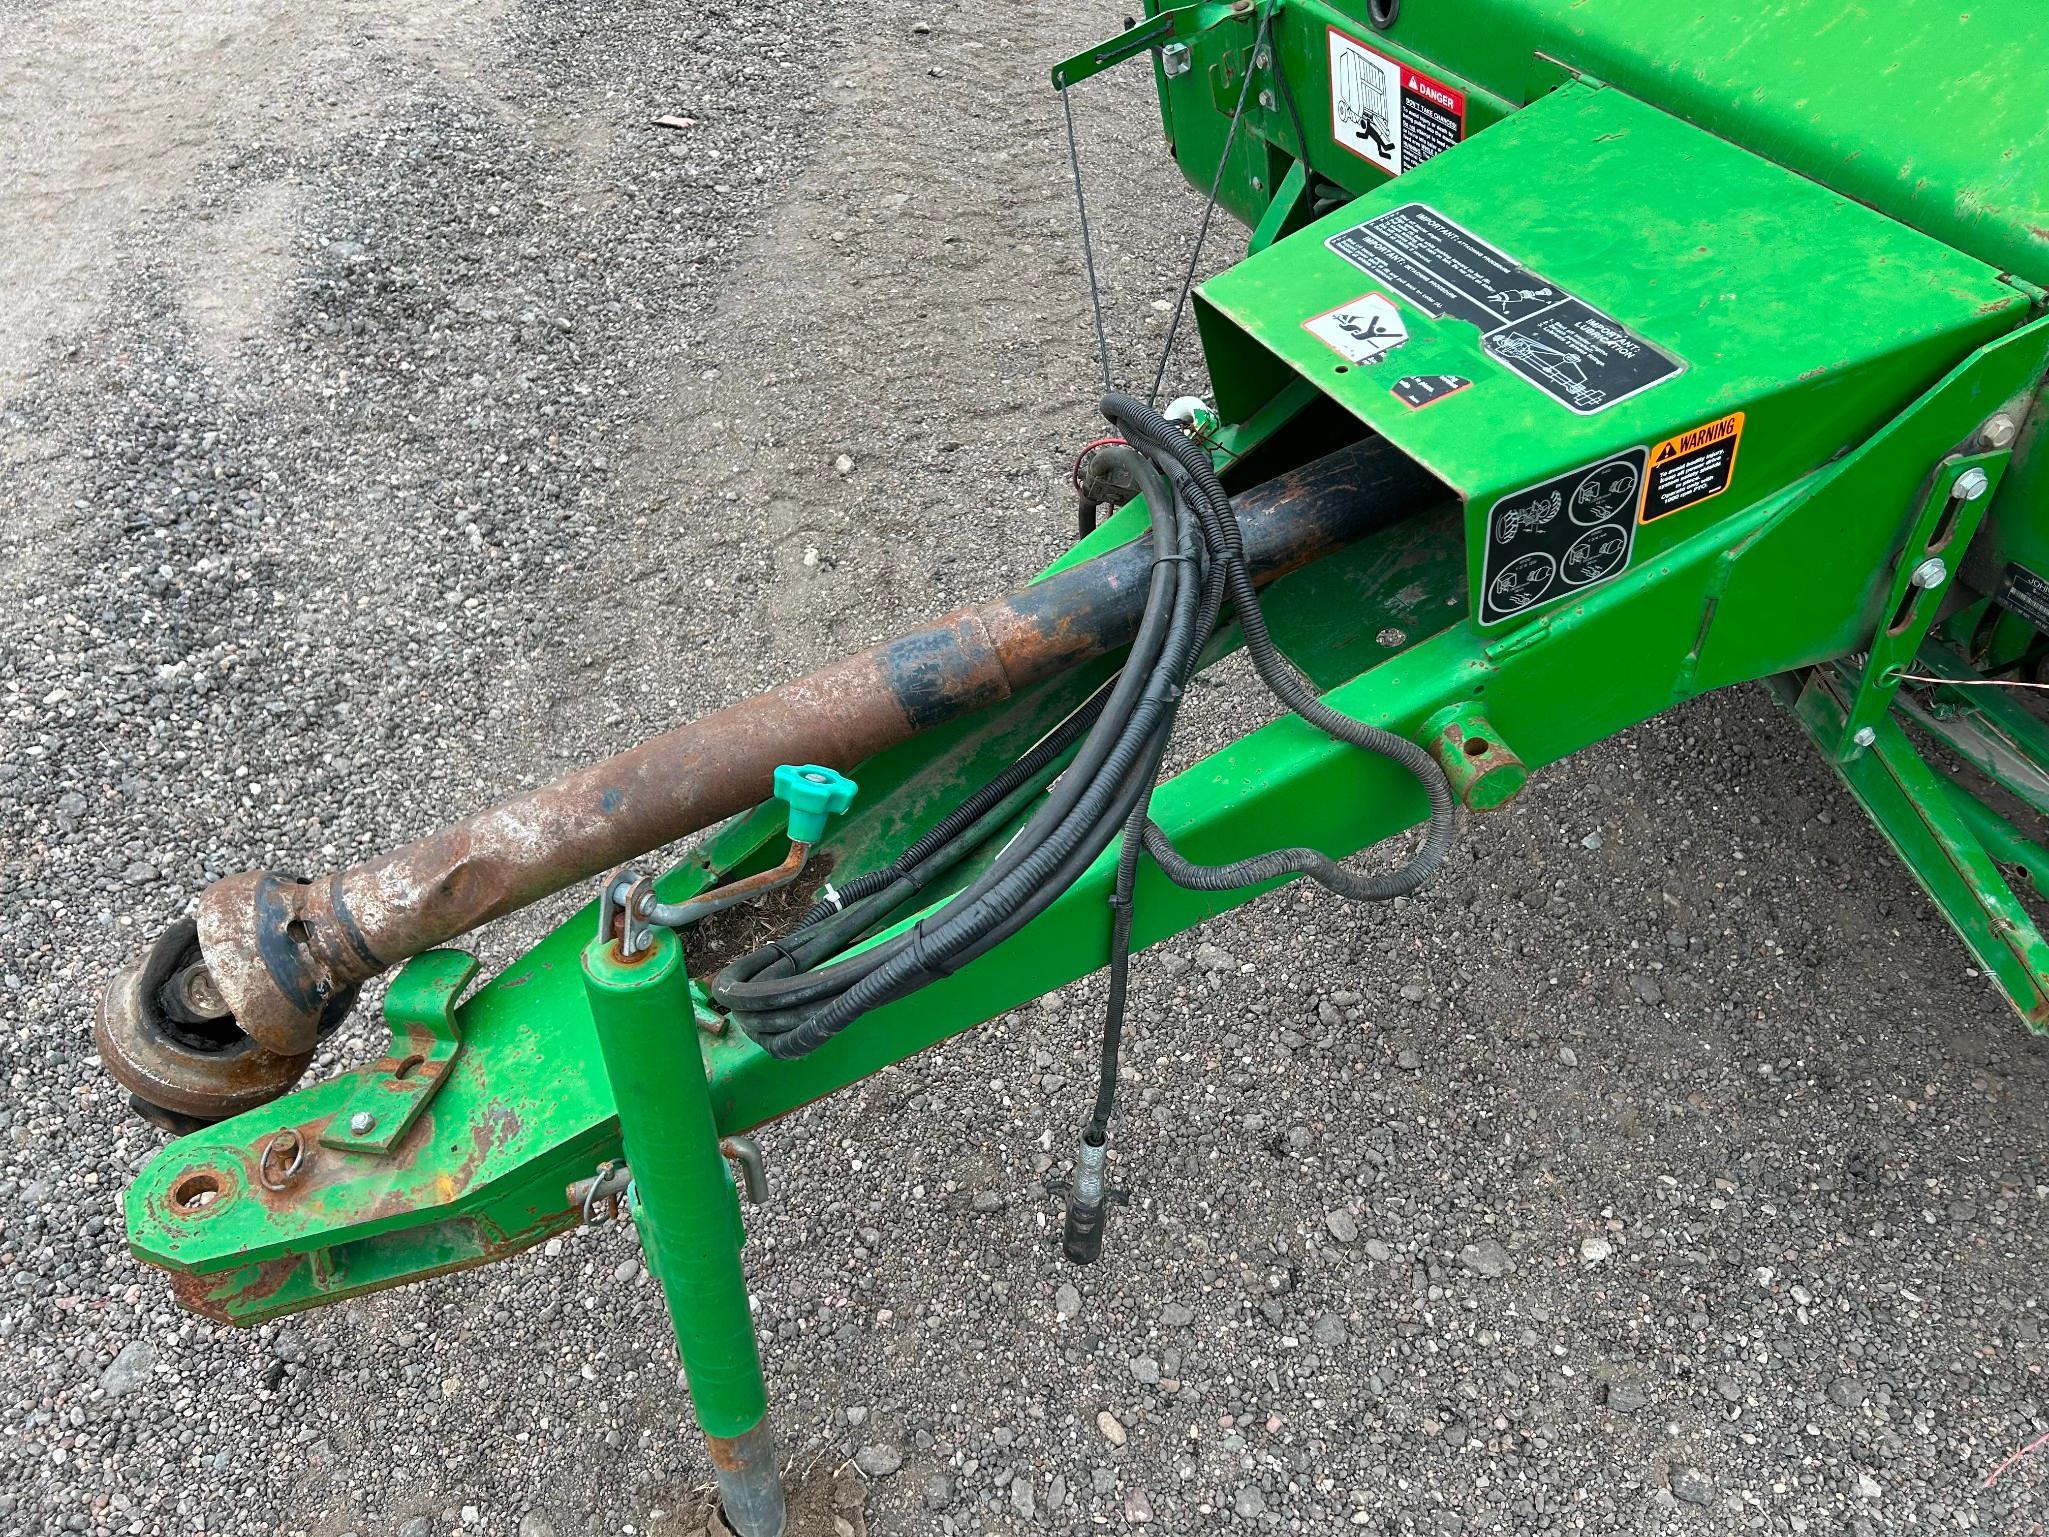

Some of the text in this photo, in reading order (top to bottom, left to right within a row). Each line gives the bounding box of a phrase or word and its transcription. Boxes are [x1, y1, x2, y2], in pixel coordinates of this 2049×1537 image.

[1420, 83, 1453, 109] DANGER
[1421, 106, 1433, 116] TAKE
[1416, 213, 1459, 241] IMPORTANT:
[1362, 236, 1405, 265] IMPORTANT:
[1574, 322, 1635, 358] LUBRICATION
[1586, 319, 1640, 352] IMPORTANT:
[1680, 418, 1734, 452] WARNING
[1668, 464, 1685, 474] avoid
[1686, 457, 1705, 467] bodily
